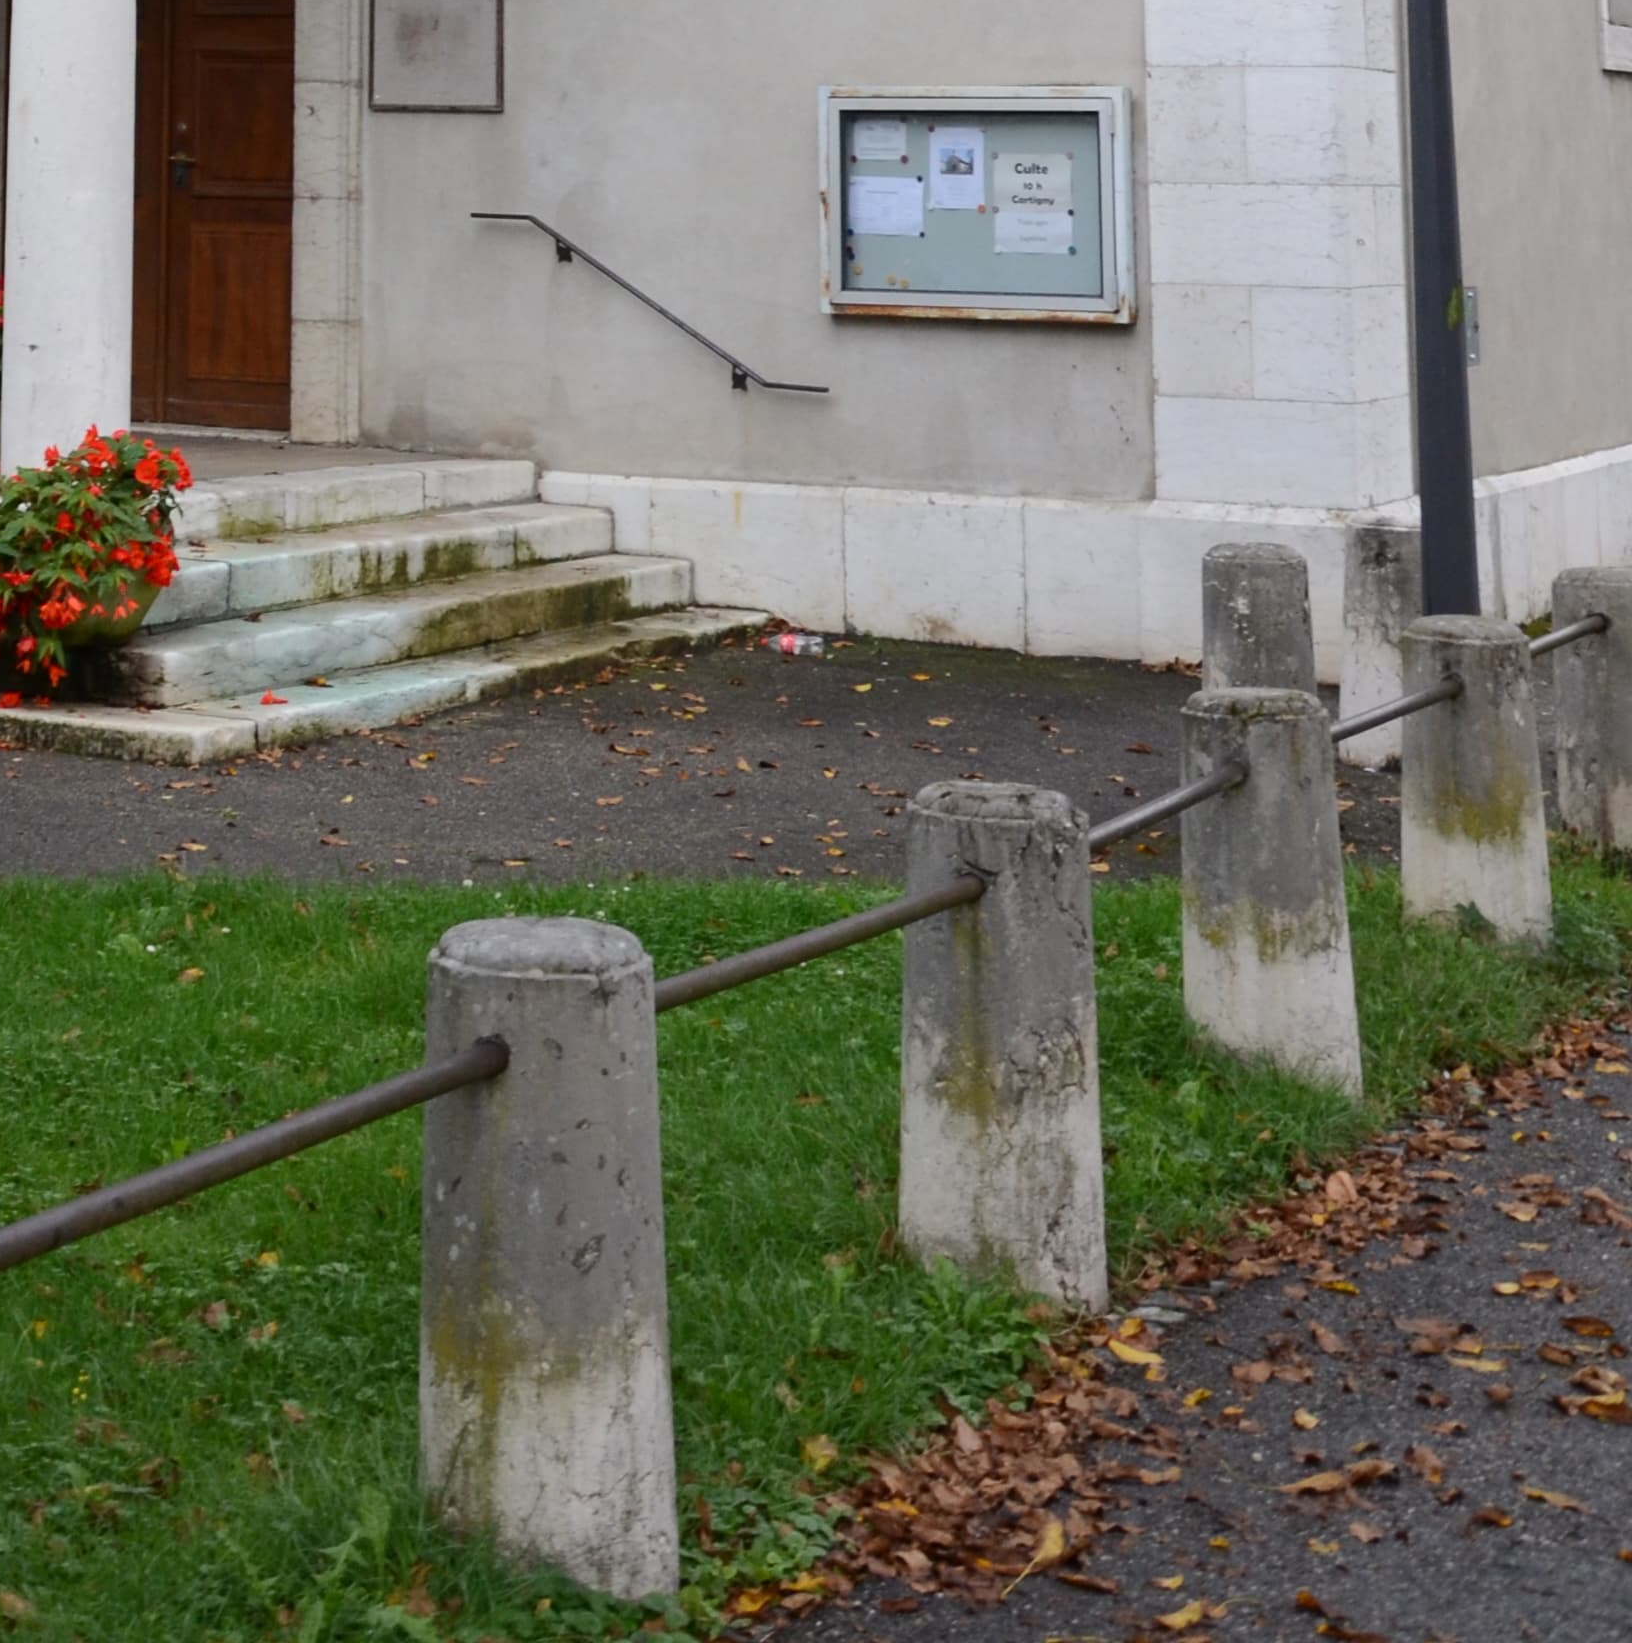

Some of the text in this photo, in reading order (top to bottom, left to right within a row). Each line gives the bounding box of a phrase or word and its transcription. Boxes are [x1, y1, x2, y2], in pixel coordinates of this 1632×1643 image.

[1014, 163, 1049, 175] Culte
[1023, 182, 1043, 190] 10 h
